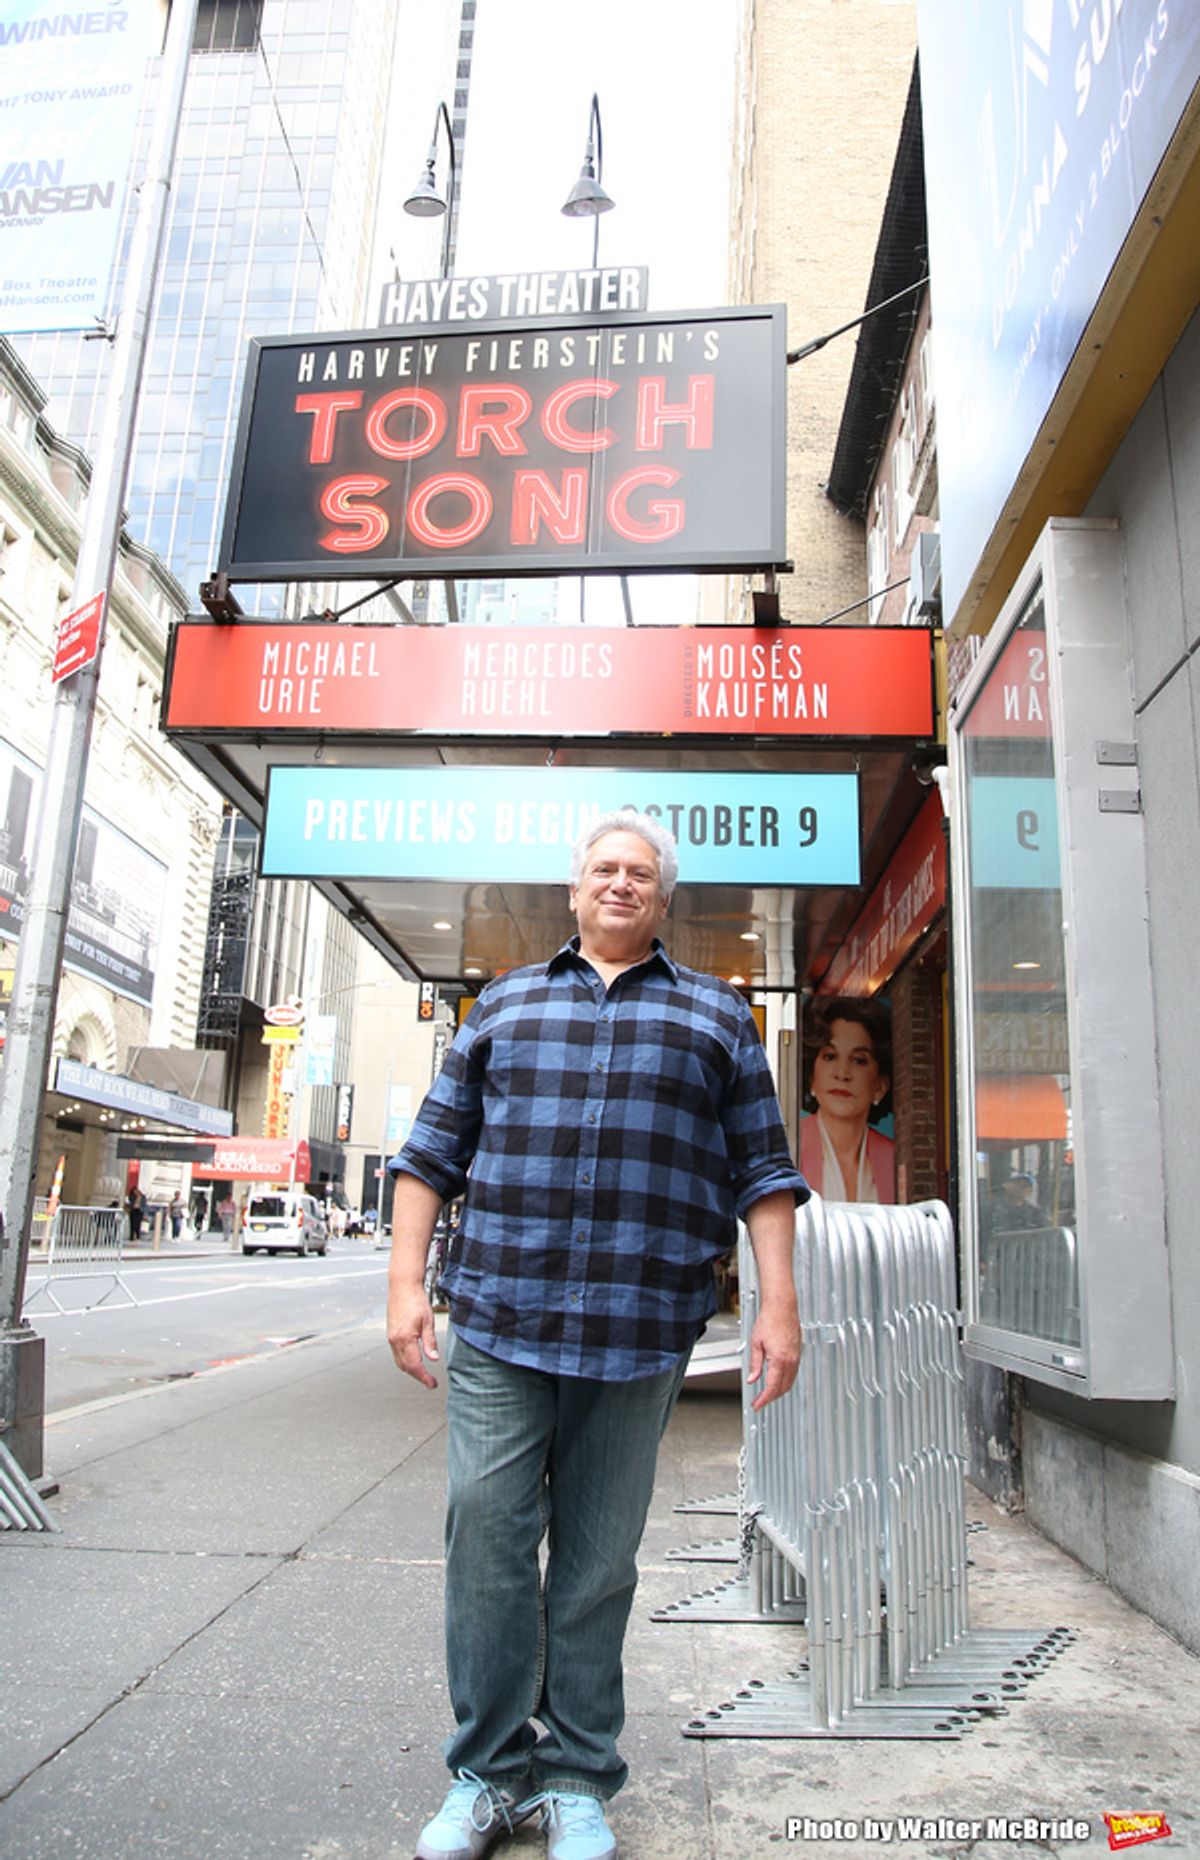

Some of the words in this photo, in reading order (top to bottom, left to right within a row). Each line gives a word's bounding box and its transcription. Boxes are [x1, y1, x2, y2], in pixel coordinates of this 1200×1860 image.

[0, 11, 129, 46] WINNER
[24, 89, 68, 105] TONY
[70, 83, 133, 101] AWARD
[1051, 205, 1085, 301] ONLY
[1089, 170, 1100, 210] 2
[1099, 0, 1169, 180] BLOCKS
[992, 120, 1068, 352] DONNA
[2, 280, 32, 292] Box
[38, 275, 98, 290] Theatre
[384, 277, 490, 325] HAYES
[497, 267, 641, 318] THEATER
[297, 344, 438, 383] HARVEY
[465, 330, 721, 373] FIERSTEIN'S
[294, 373, 715, 464] TORCH
[319, 464, 686, 554] SONG
[262, 641, 380, 677] MICHAEL
[463, 642, 614, 679] MERCEDES
[696, 639, 803, 680] MOISÉS
[258, 678, 324, 714] URIE
[461, 679, 553, 717] RUEHL
[696, 682, 828, 719] KAUFMAN
[304, 799, 477, 844] PREVIEWS
[620, 803, 780, 848] TOBER
[799, 806, 818, 848] 9
